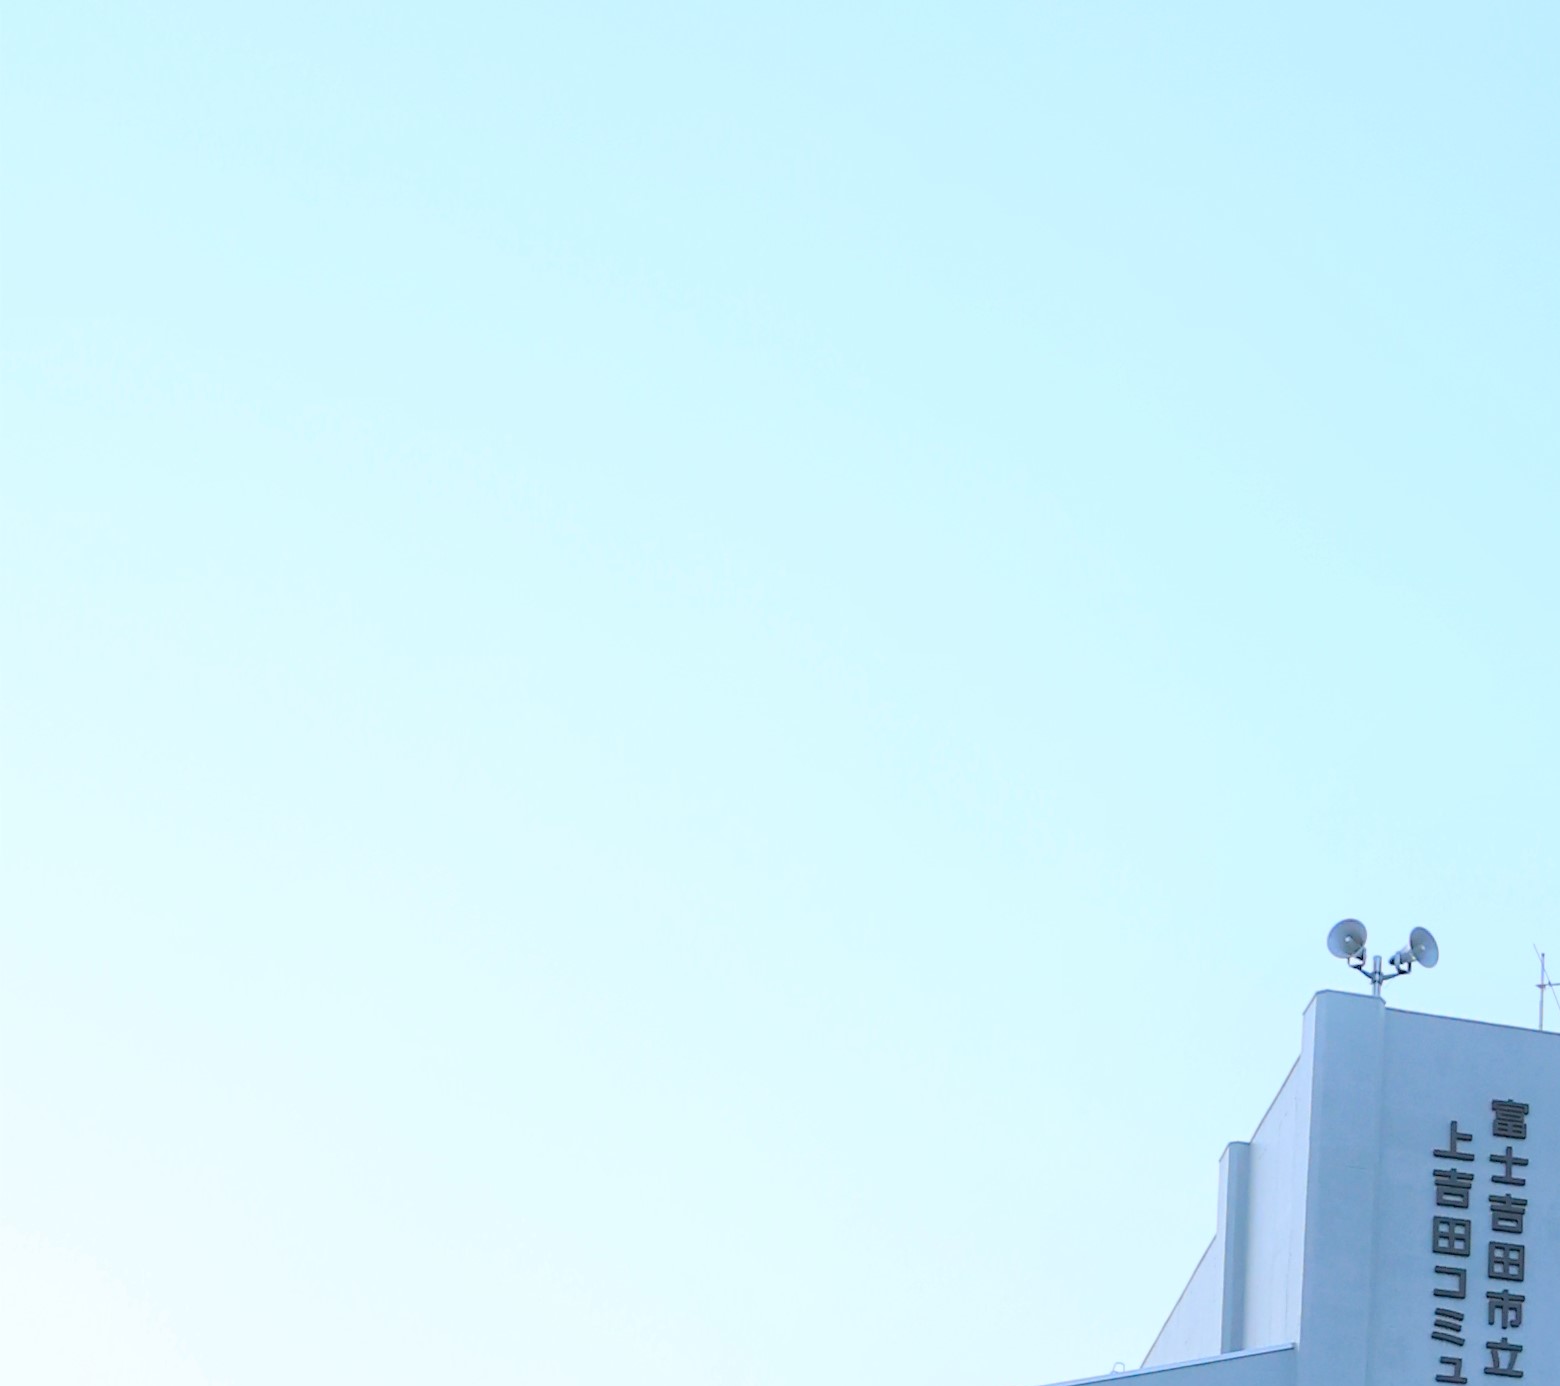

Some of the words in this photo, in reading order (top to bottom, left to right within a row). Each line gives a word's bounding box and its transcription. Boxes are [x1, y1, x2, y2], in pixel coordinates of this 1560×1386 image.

[1483, 1098, 1530, 1379] 富士吉田市立
